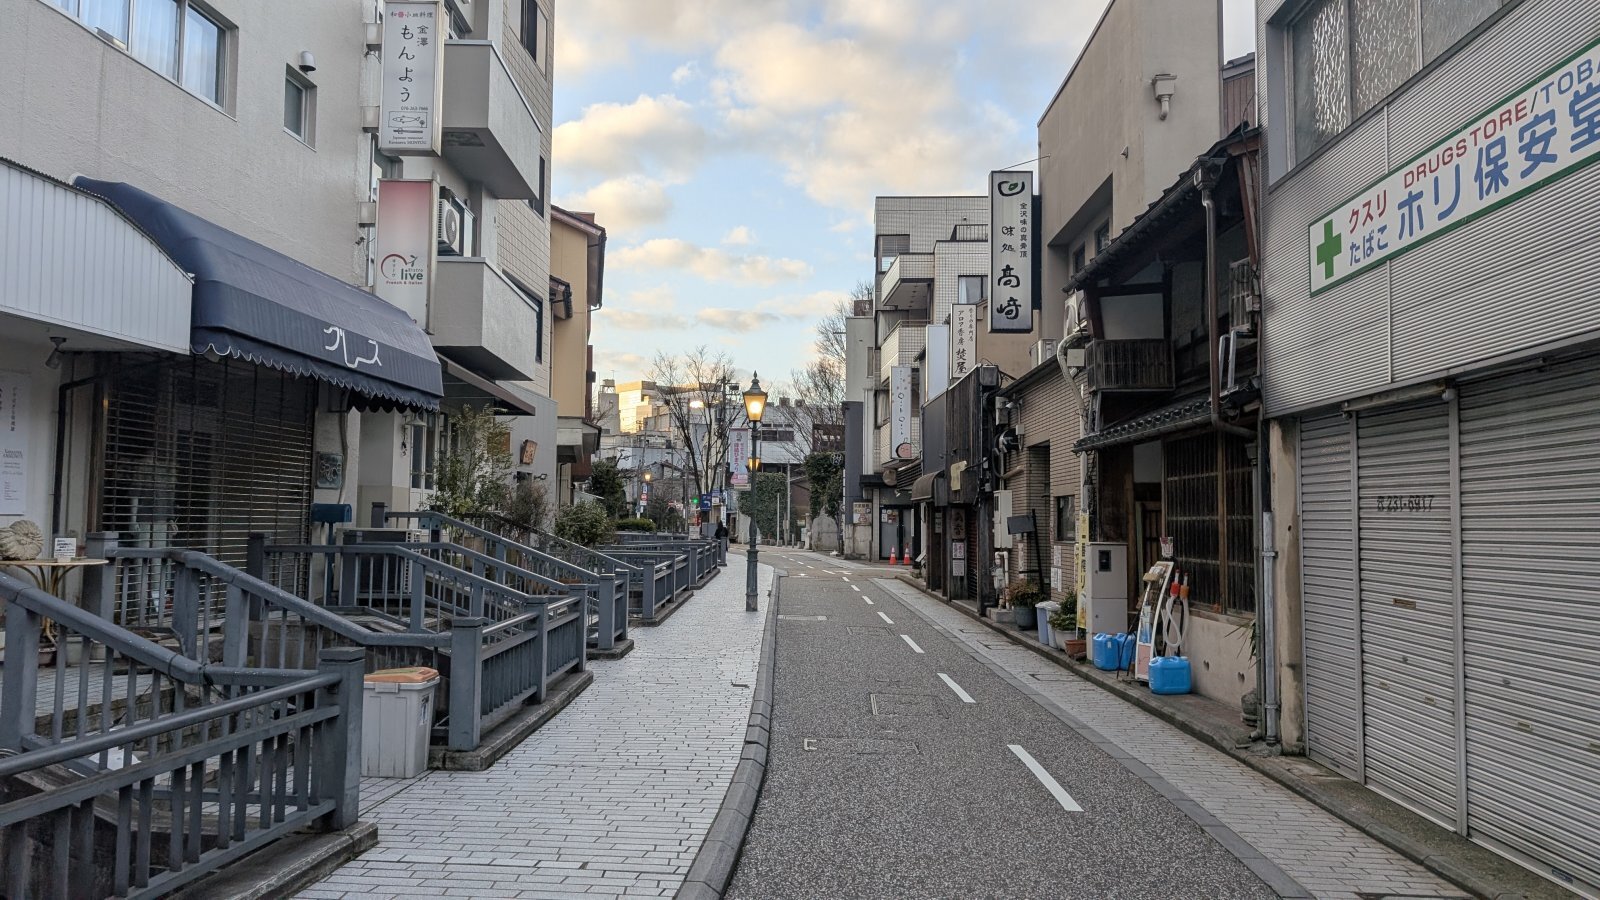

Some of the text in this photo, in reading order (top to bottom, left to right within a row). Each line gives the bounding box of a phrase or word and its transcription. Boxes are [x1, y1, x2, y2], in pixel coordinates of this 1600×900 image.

[398, 24, 415, 102] もんよう
[1404, 58, 1600, 189] DRUGSTORE/TOB
[1349, 190, 1387, 233] クスリ
[1350, 225, 1389, 266] たばこ
